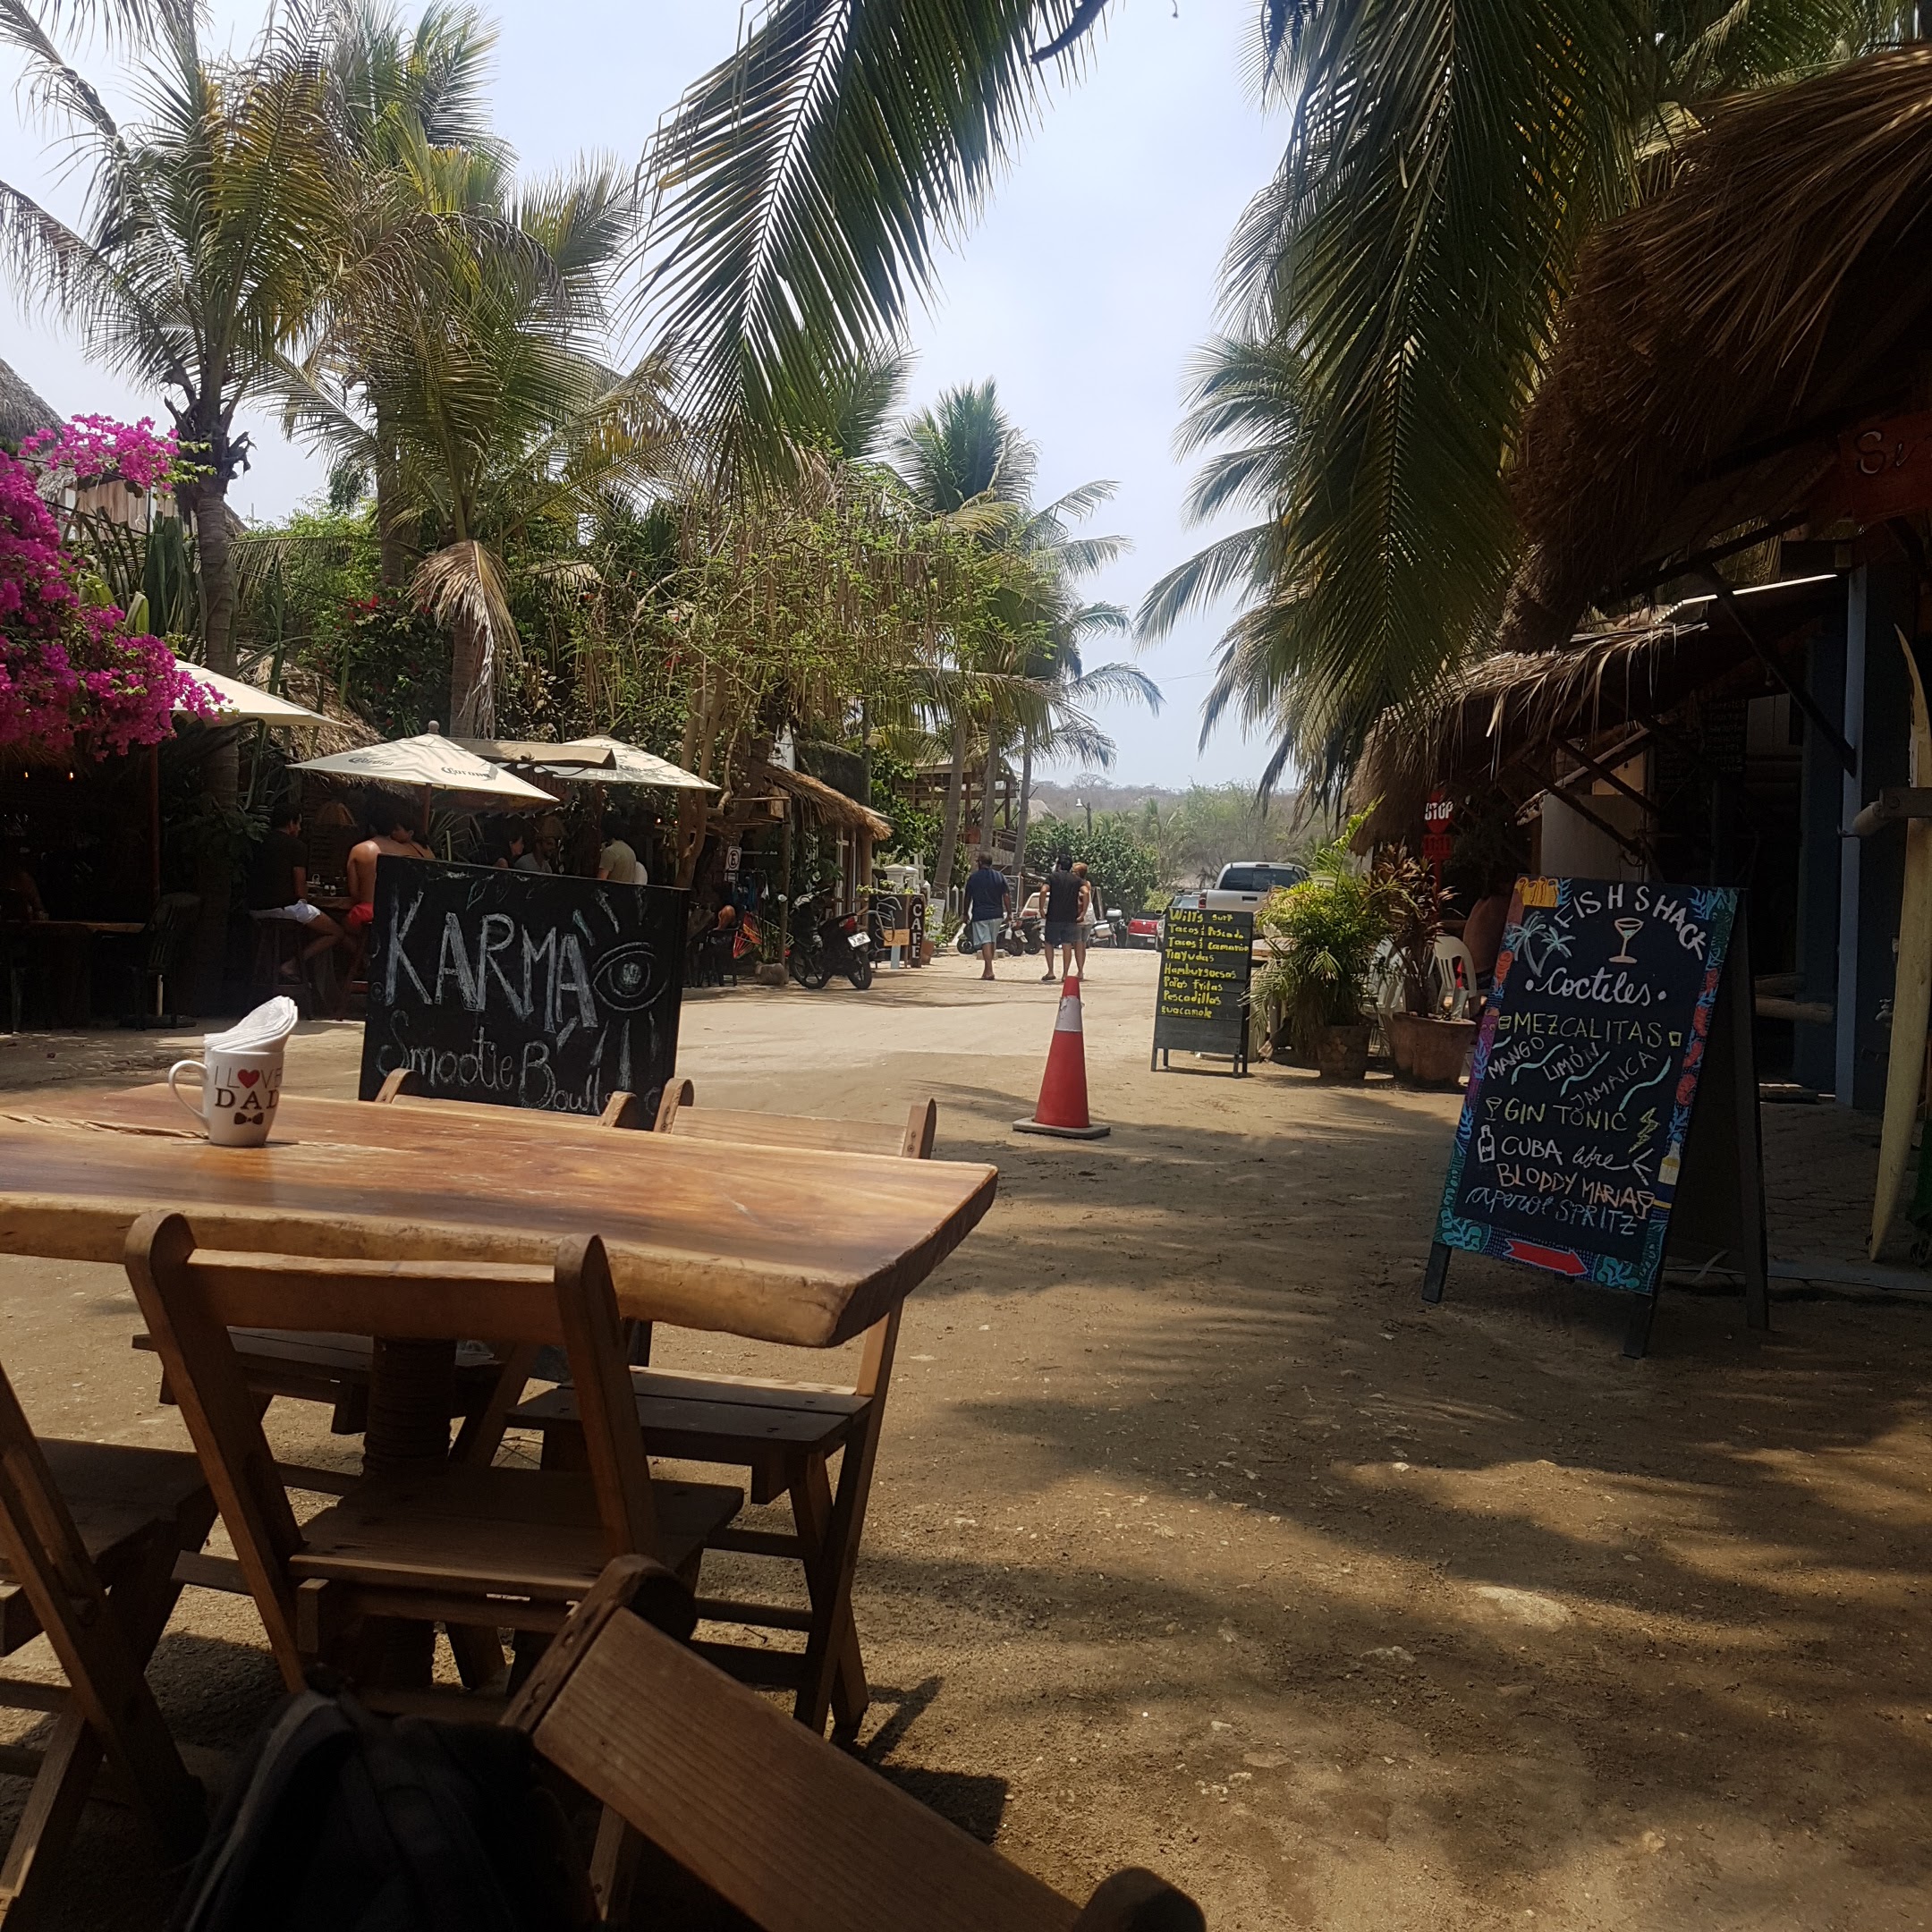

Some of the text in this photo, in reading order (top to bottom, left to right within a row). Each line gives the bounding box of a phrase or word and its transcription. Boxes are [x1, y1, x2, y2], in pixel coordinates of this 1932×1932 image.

[1424, 800, 1454, 821] STOP
[1167, 923, 1199, 935] Tacos
[1554, 883, 1707, 961] FISH SHACK
[1167, 936, 1197, 948] Tacos
[385, 889, 598, 1034] KARMA
[1164, 962, 1237, 979] Hamburguesas
[1163, 989, 1222, 1005] Pescadillas
[1535, 966, 1651, 1007] Cocteles
[1513, 1012, 1663, 1048] MEZCALITAS
[1487, 1036, 1545, 1080] MANGO
[1570, 1050, 1657, 1111] JAMAICA
[215, 1087, 280, 1110] DAD
[1504, 1097, 1628, 1132] GIN TONIC
[1501, 1136, 1563, 1166] CUBA
[1496, 1163, 1578, 1195] BLODDY
[1555, 1199, 1639, 1236] SPRITZ
